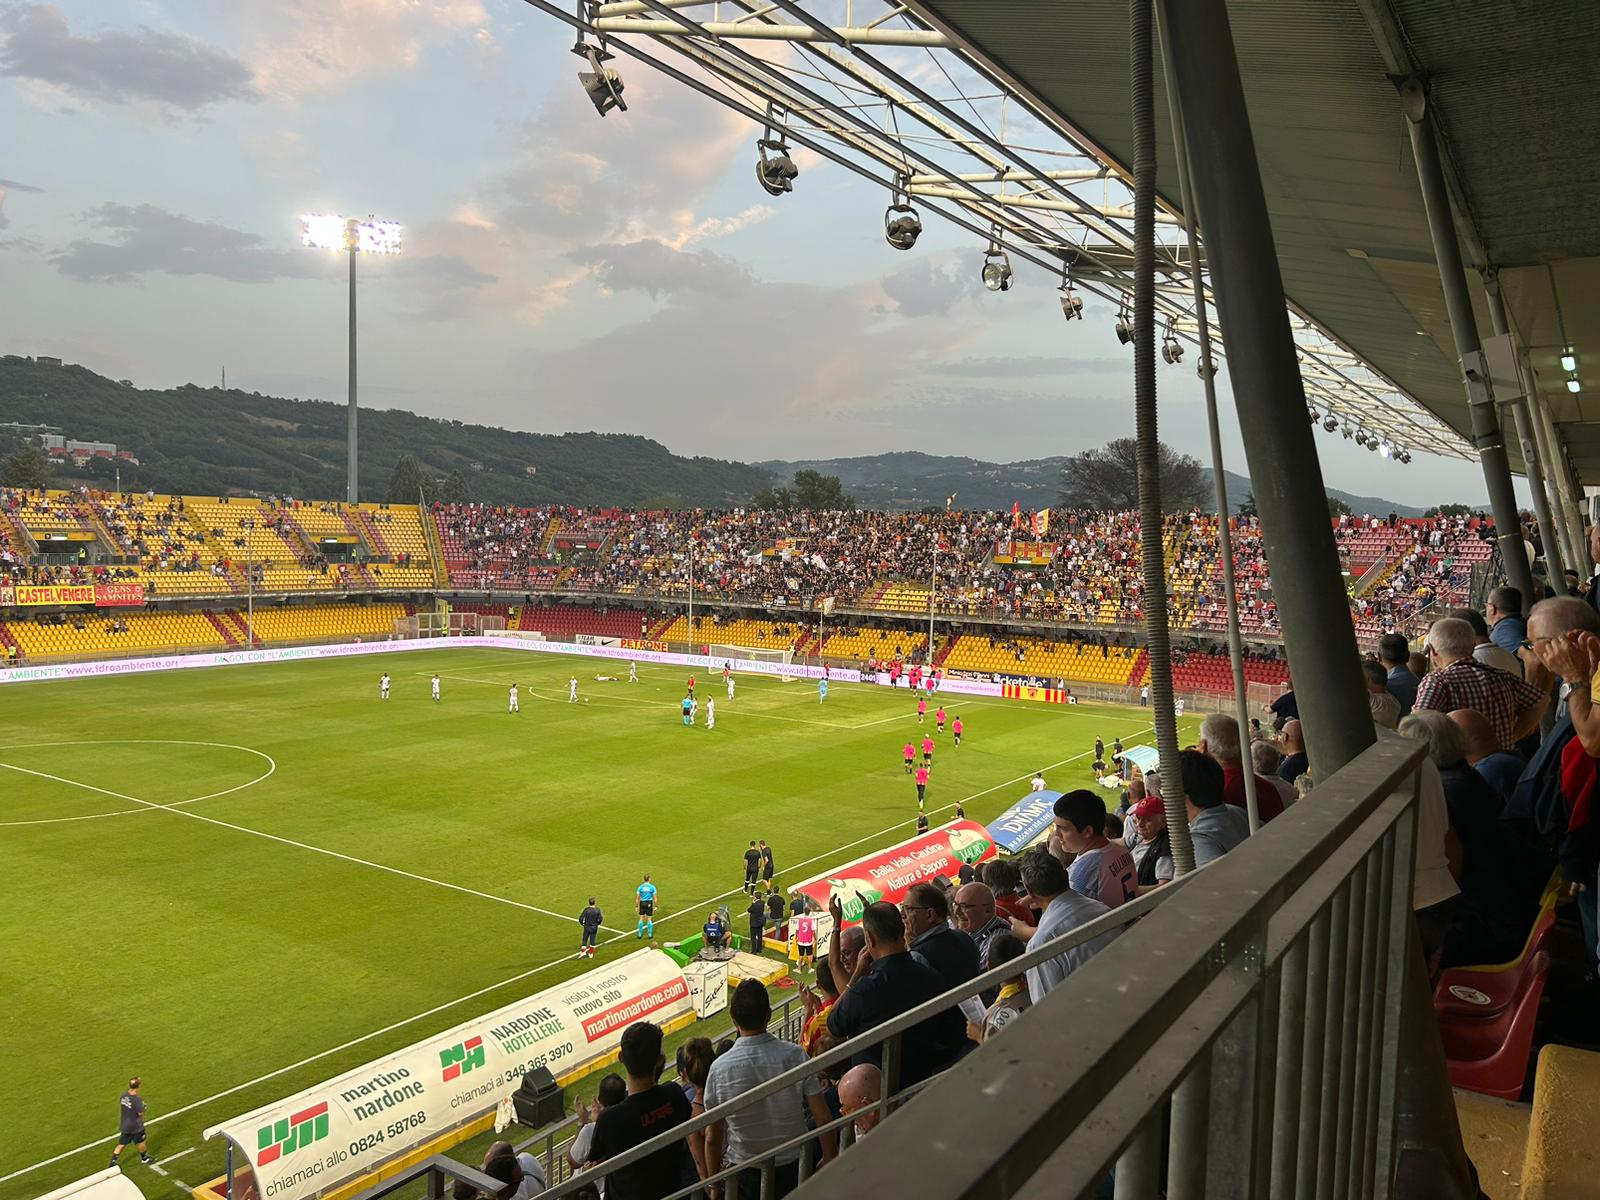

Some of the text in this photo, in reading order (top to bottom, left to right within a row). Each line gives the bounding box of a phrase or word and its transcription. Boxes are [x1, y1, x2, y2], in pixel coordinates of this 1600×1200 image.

[18, 587, 94, 603] CASTELVENERE
[96, 592, 143, 600] SAMNITES
[229, 653, 245, 662] GOL
[248, 651, 264, 660] CON
[621, 639, 667, 652] PETRONE
[869, 842, 945, 878] Dalla Valle Caudina
[887, 857, 949, 892] Natura e Sapore
[841, 894, 875, 920] MAUO
[802, 922, 808, 932] 5
[562, 973, 628, 1006] visita il nostro
[573, 988, 622, 1018] nuovo sito
[490, 1006, 556, 1041] NARDONE
[586, 980, 685, 1037] martinonardone.com
[502, 1018, 566, 1054] HOTELLERIE
[340, 1066, 410, 1103] martino
[450, 1042, 573, 1109] chiamaci al 348 365 3970
[353, 1079, 425, 1121] nardone
[265, 1110, 427, 1197] chiamaci allo 0824 58768
